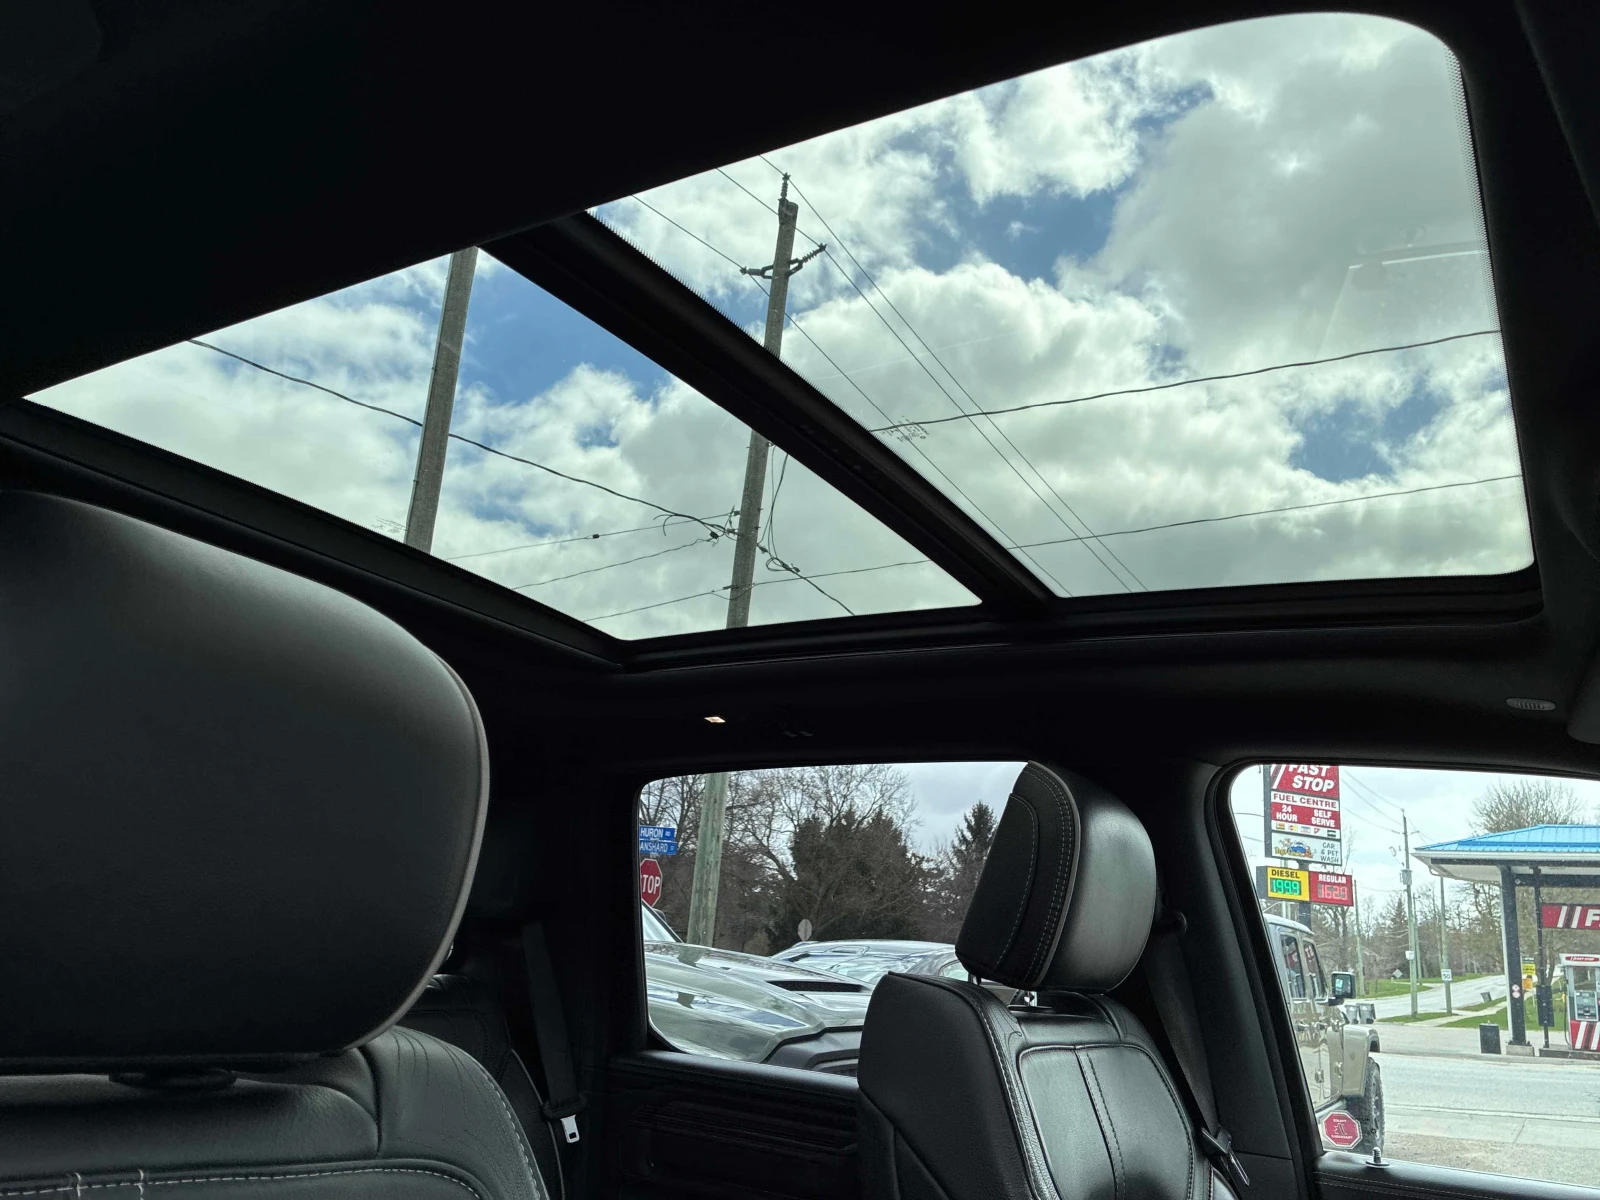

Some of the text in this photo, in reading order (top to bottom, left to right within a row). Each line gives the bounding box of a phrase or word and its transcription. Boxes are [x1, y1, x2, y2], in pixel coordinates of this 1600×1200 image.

[1292, 775, 1335, 793] STOP
[1273, 793, 1337, 809] FUEL CENTRE
[1281, 805, 1292, 813] 24
[1313, 809, 1332, 818] SELF
[1276, 813, 1298, 823] HOUR
[1311, 817, 1336, 828] SERVE
[640, 828, 663, 838] HURON
[639, 842, 668, 852] ANSHARD
[1322, 842, 1336, 850] CAR
[1320, 855, 1340, 863] WASH
[1271, 869, 1300, 879] DIESEL
[1318, 873, 1347, 884] REGULAR
[640, 874, 660, 894] TOP
